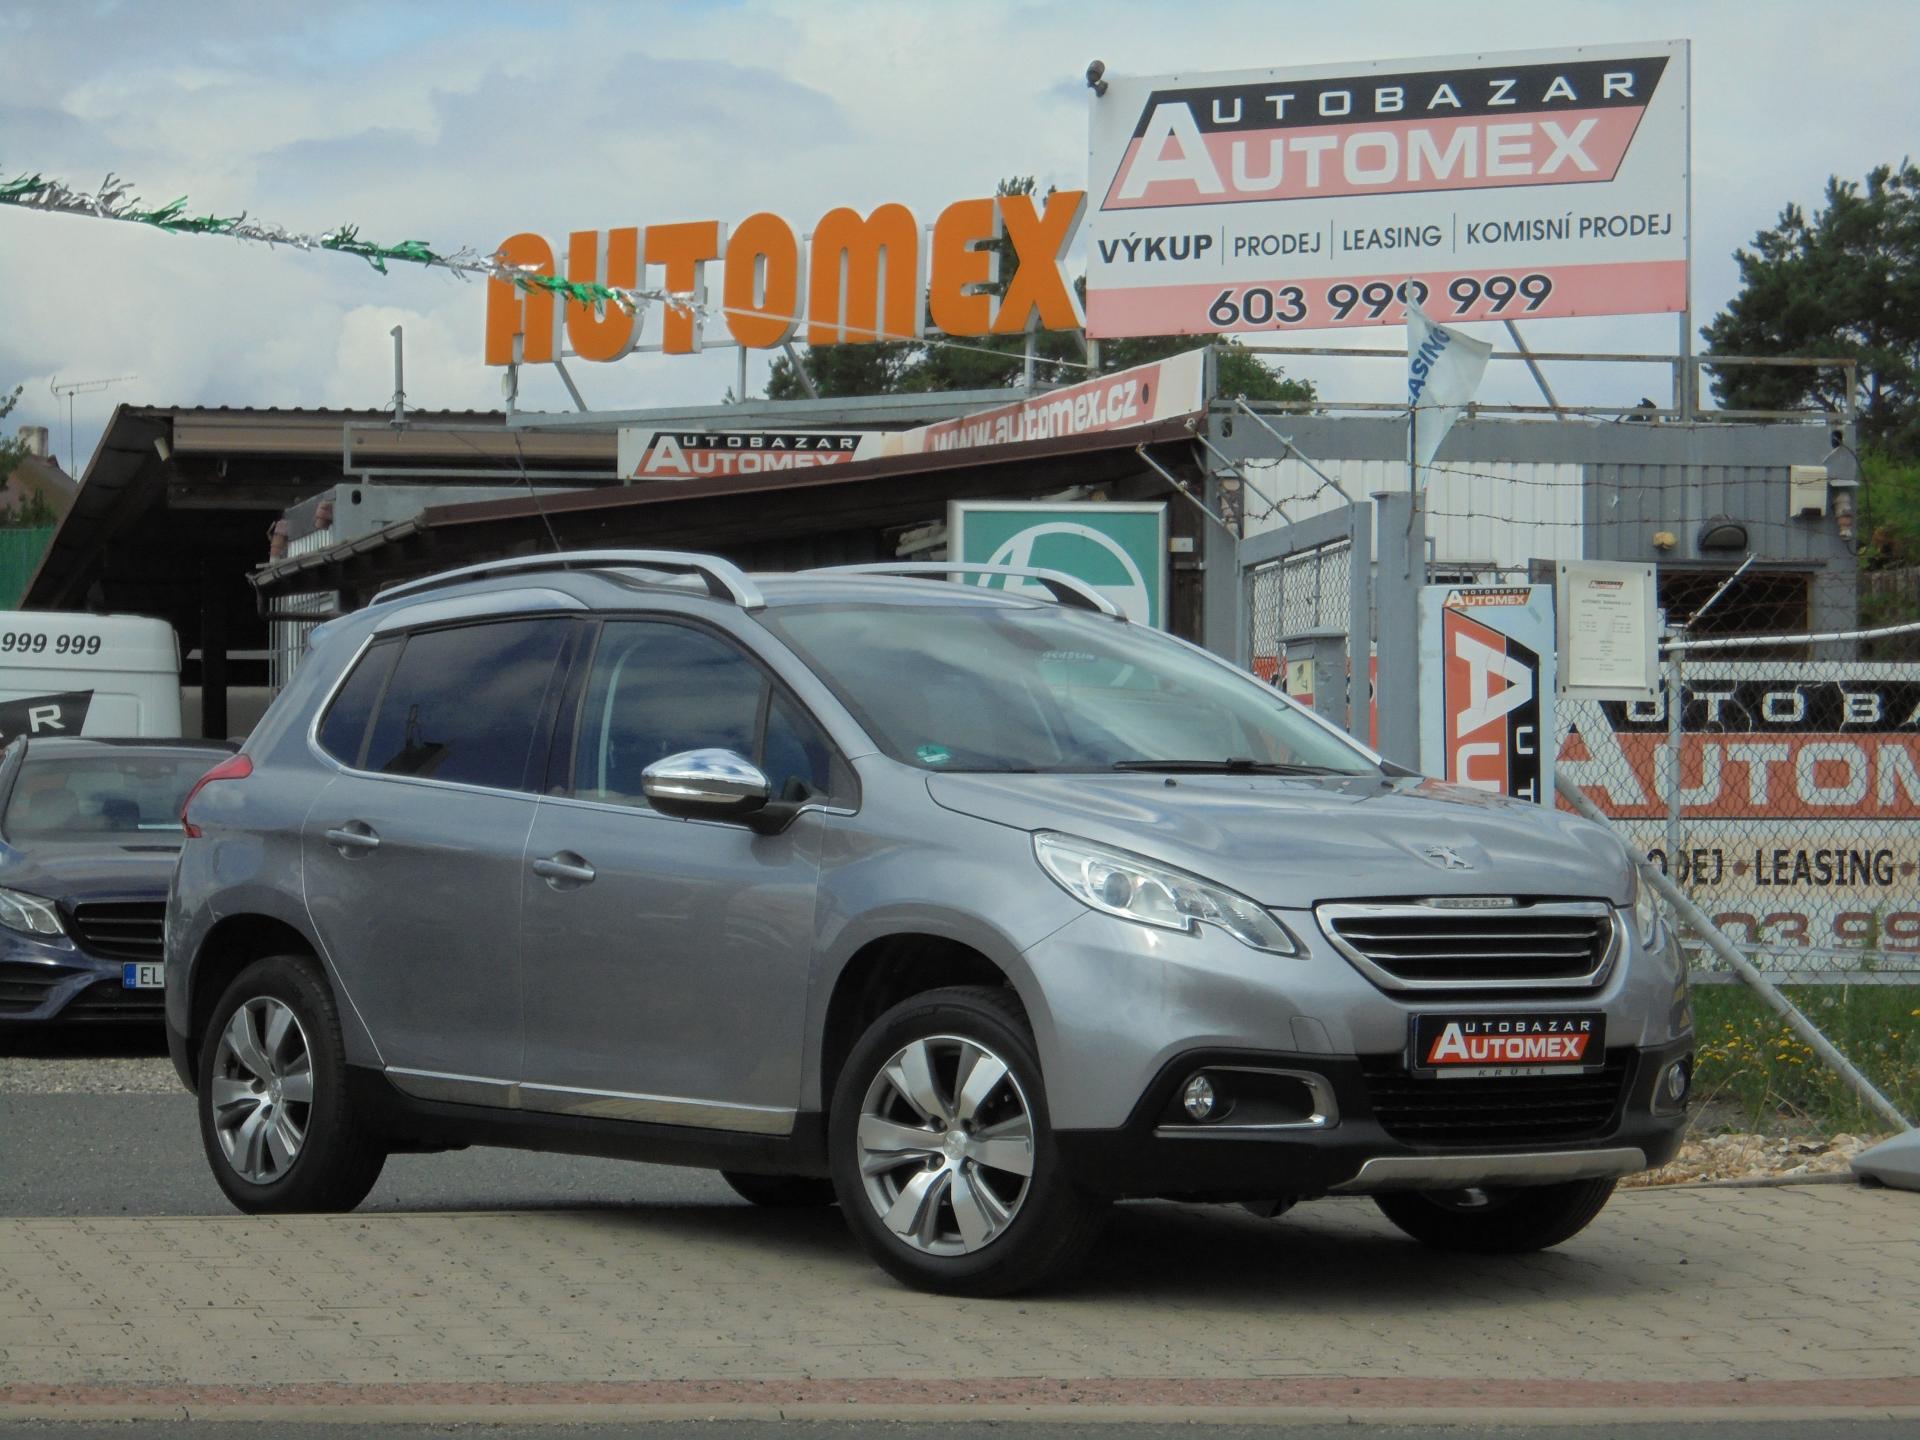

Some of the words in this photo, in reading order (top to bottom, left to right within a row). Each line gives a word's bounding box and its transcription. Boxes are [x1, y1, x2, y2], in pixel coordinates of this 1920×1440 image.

[1118, 101, 1600, 201] AUTOMEX
[1098, 231, 1214, 264] VÝKUP
[1234, 232, 1322, 259] PRODEJ
[1343, 225, 1443, 252] LEASING
[1466, 211, 1572, 245] KOMISNÍ
[1580, 213, 1673, 240] PRODEJ
[485, 191, 1088, 366] AUTOMEX
[1208, 286, 1308, 327] 603
[1327, 279, 1430, 322] 999
[1447, 273, 1554, 315] 999
[1446, 590, 1525, 606] AUTOMEX
[1, 632, 48, 653] 999
[55, 634, 102, 655] 999
[1755, 849, 1894, 887] LEASING
[1433, 1023, 1581, 1060] AUTOMEX
